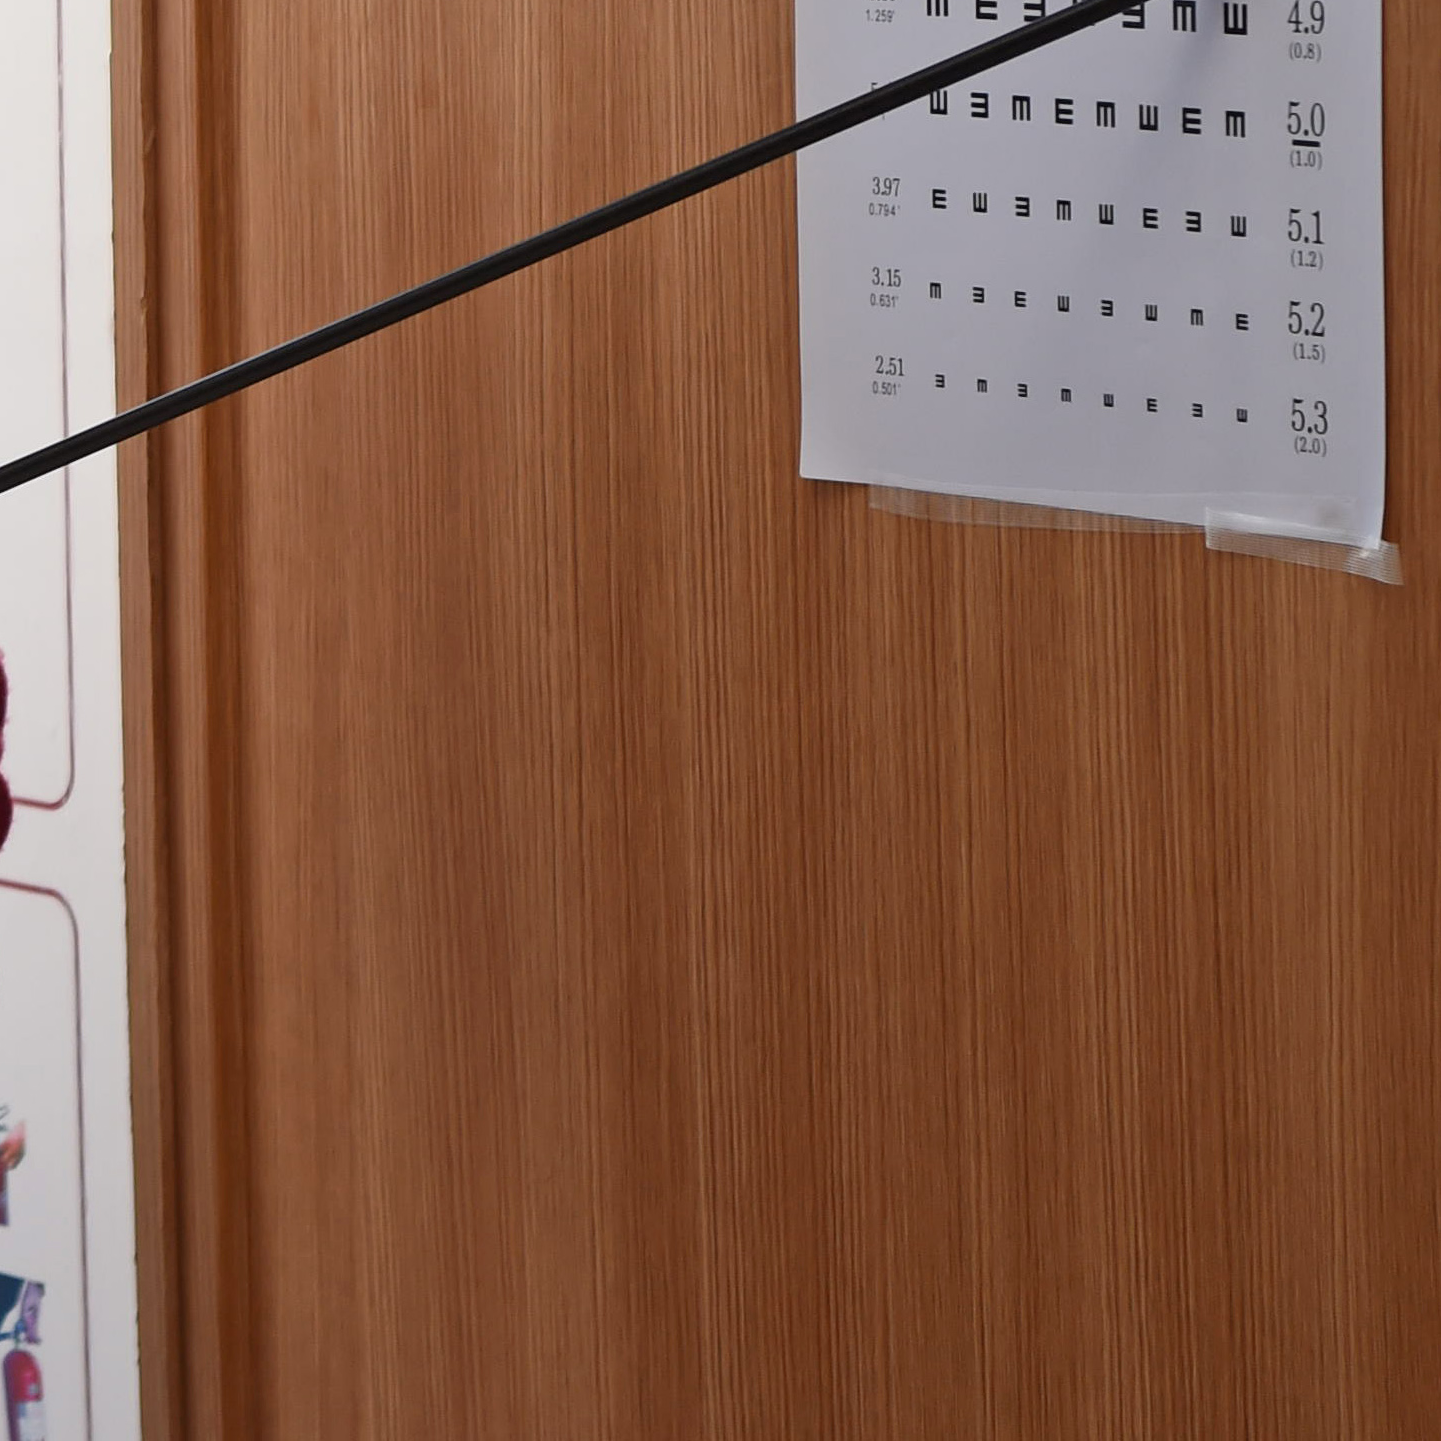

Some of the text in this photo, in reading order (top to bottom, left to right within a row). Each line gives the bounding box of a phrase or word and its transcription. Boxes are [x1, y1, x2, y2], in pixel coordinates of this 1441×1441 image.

[1286, 0, 1326, 35] 4.9
[1288, 41, 1322, 63] (0.8)
[1286, 100, 1326, 138] 5.0
[1289, 149, 1322, 168] (1.0)
[871, 176, 901, 198] 3.97
[1287, 208, 1325, 245] 5.1
[1290, 248, 1324, 271] (1.2)
[871, 266, 902, 288] 3.15
[1287, 300, 1326, 338] 5.2
[1292, 342, 1326, 364] (1.5)
[874, 354, 905, 377] 2.51
[1291, 397, 1329, 435] 5.3
[1293, 435, 1328, 458] (2.0)
